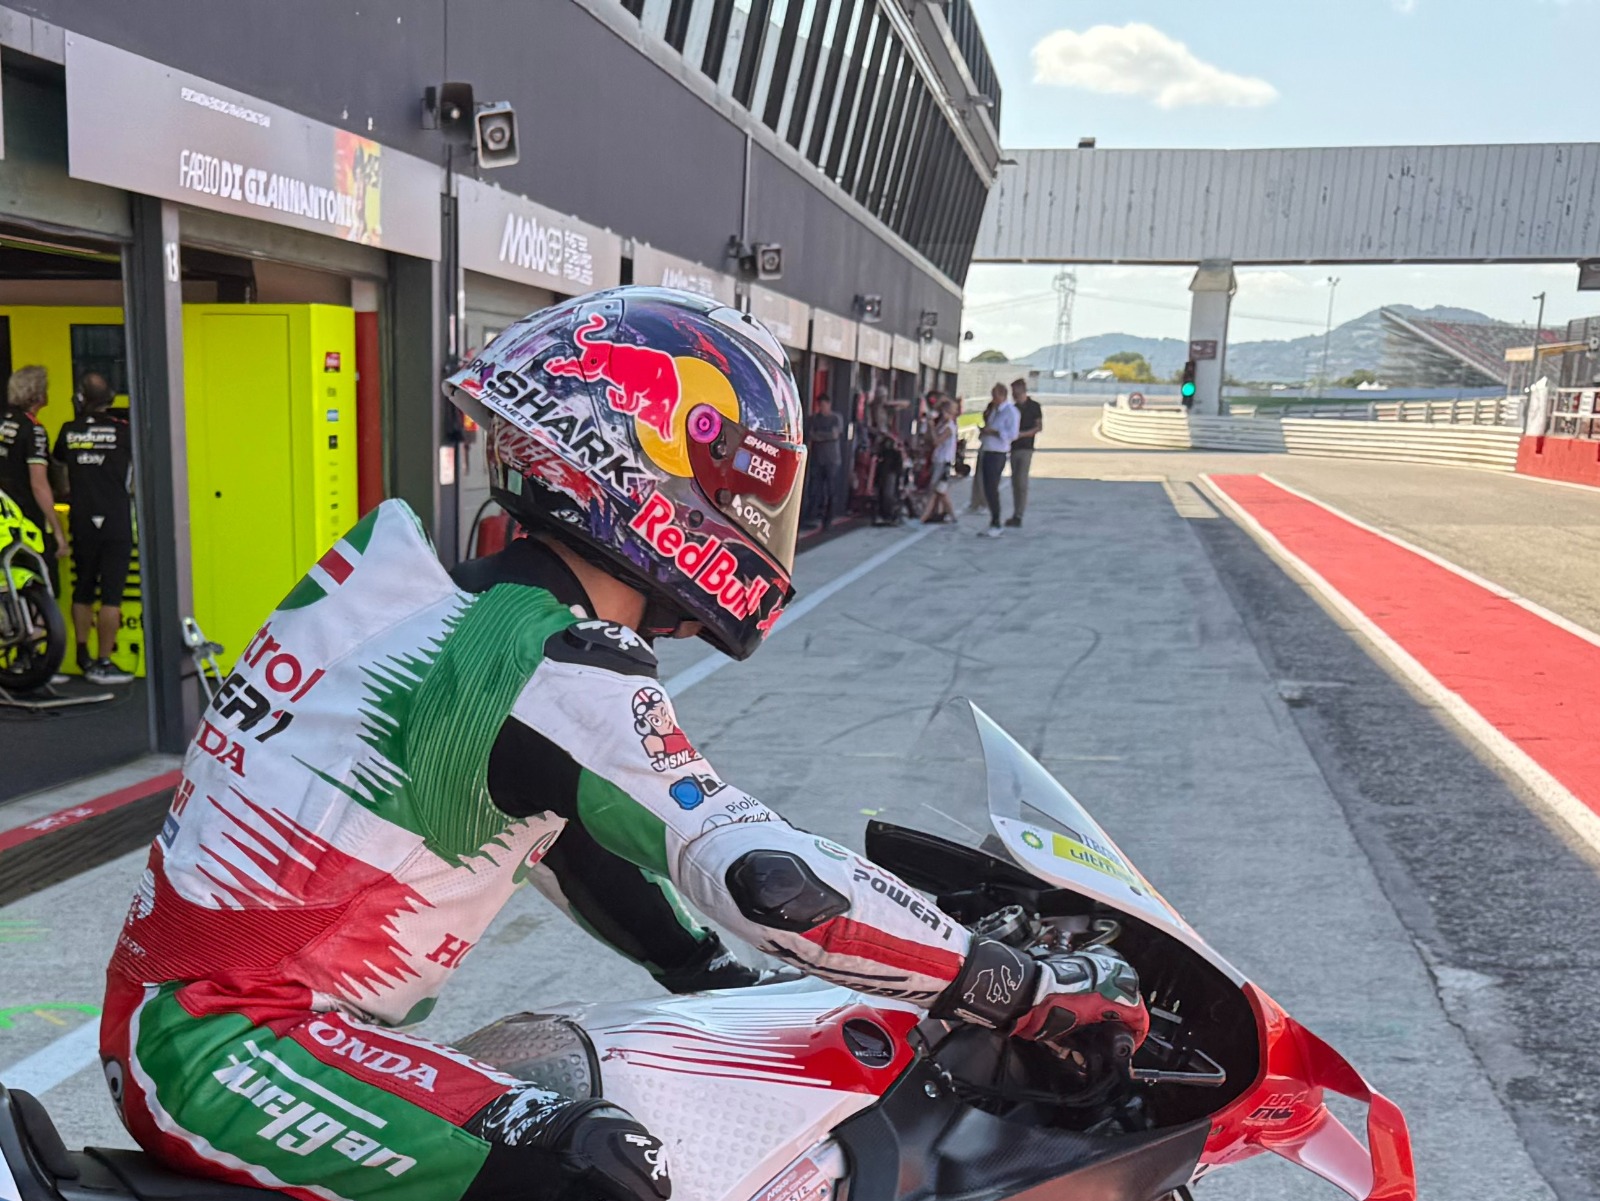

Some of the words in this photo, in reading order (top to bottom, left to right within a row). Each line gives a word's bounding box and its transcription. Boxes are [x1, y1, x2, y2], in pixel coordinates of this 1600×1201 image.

[180, 150, 220, 195] FABIO
[220, 160, 243, 201] DI
[480, 389, 535, 429] HELMETS
[486, 370, 651, 494] SHARK
[744, 435, 779, 459] SHARK
[748, 464, 774, 486] LOCK
[629, 491, 721, 579] Red
[695, 548, 770, 621] Bull
[244, 622, 325, 703] trol
[211, 672, 294, 743] ER1
[193, 720, 246, 778] DA
[853, 868, 953, 941] POWER1
[308, 1020, 438, 1093] ONDA
